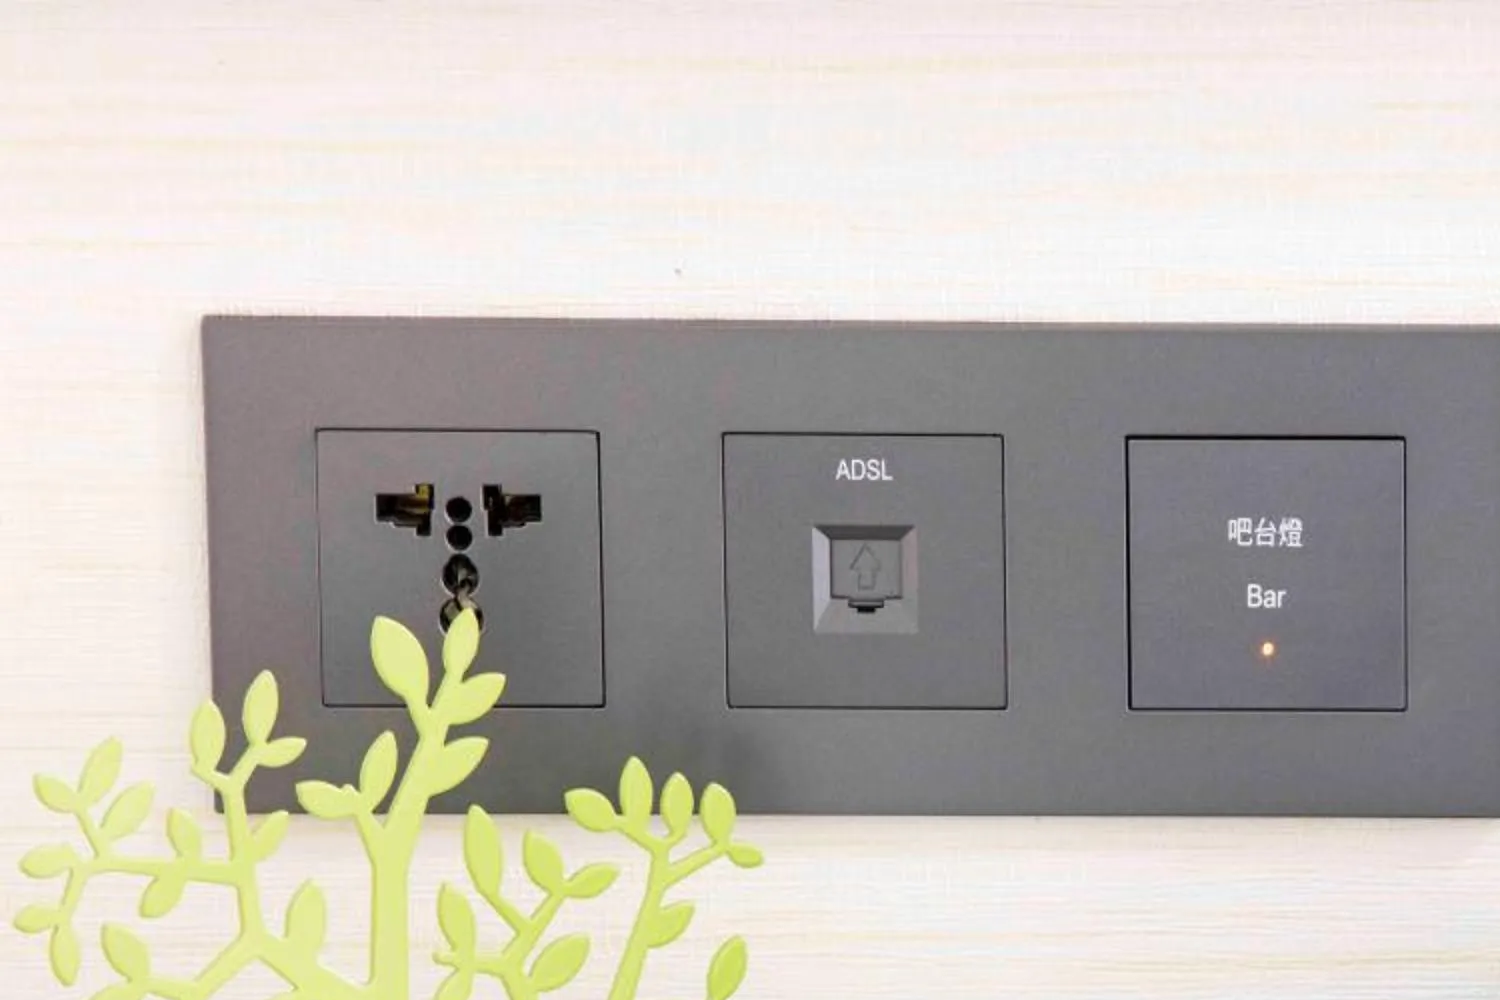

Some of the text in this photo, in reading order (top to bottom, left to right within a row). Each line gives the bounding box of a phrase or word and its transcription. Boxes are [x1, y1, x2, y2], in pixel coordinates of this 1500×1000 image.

[835, 458, 894, 481] ADSL
[1227, 516, 1304, 547] 吧台燈
[1246, 583, 1287, 609] Bar
